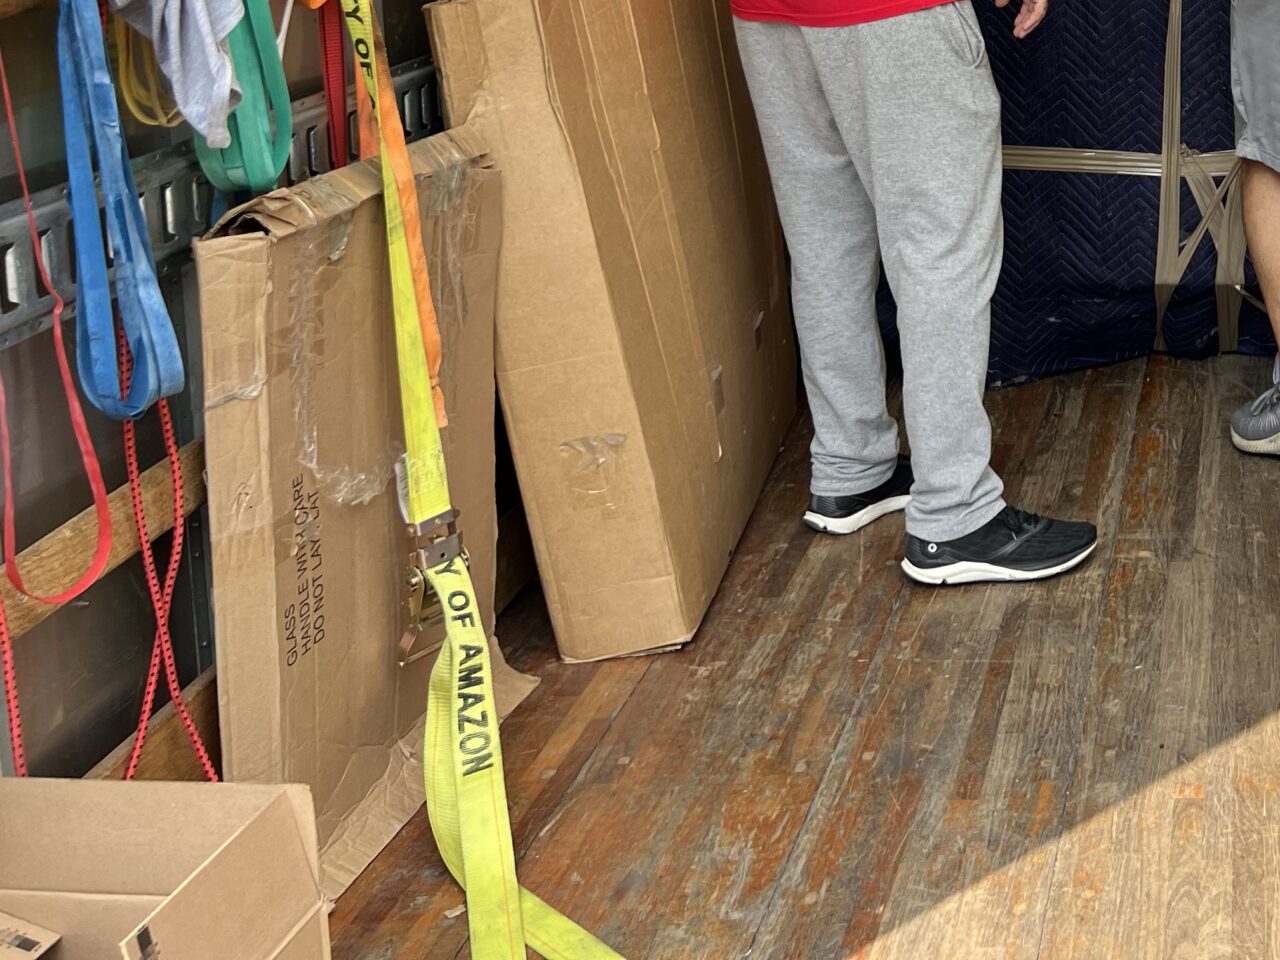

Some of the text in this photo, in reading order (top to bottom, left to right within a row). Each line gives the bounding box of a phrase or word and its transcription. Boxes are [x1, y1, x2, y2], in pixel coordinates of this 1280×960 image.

[355, 37, 374, 81] OF
[292, 473, 309, 526] CARE
[307, 490, 325, 645] DO NOT LAY LAT
[284, 603, 299, 667] GLASS
[297, 578, 312, 657] HANDLE
[447, 590, 477, 629] OF
[457, 644, 494, 777] AMAZON
